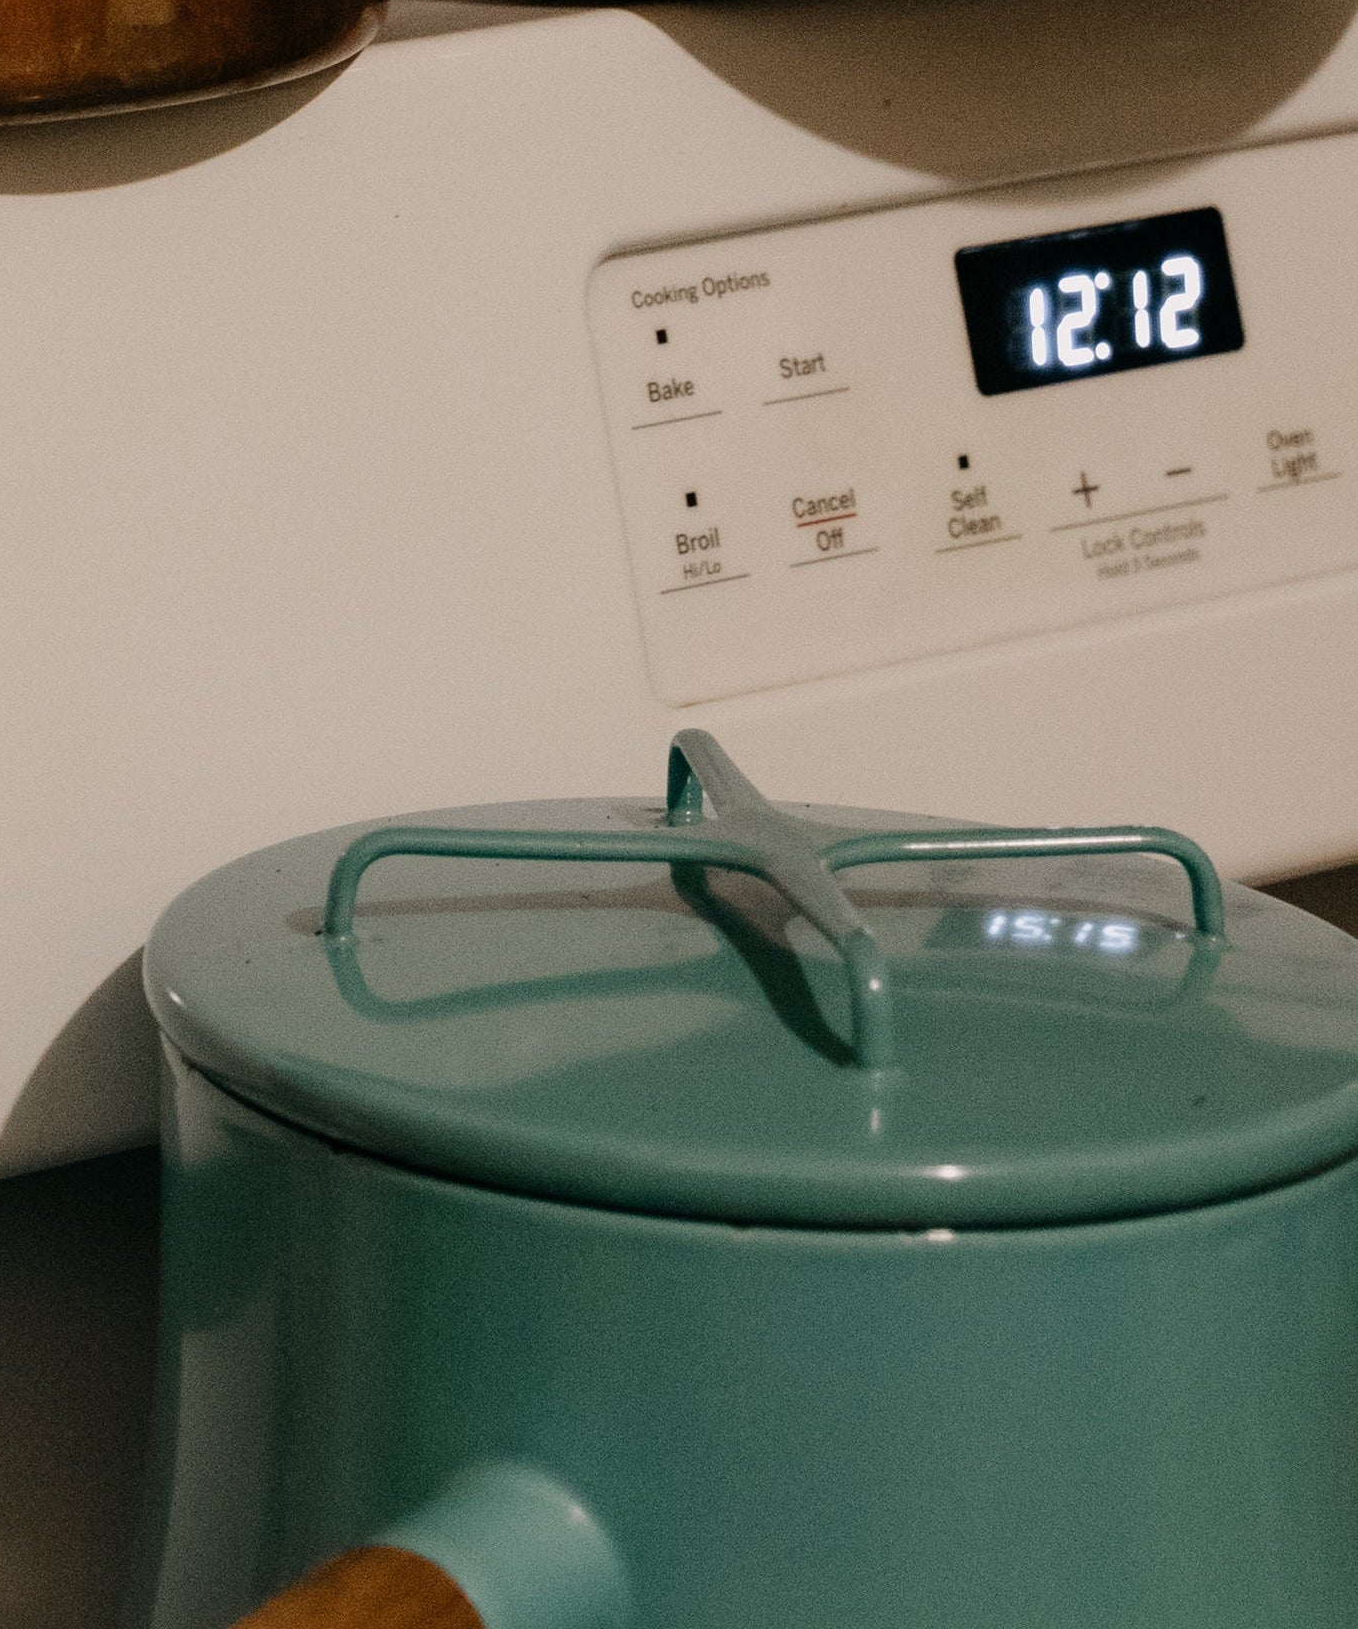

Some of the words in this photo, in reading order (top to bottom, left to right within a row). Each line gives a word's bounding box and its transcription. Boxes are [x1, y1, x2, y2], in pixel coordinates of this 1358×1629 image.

[631, 285, 700, 309] Cooking
[701, 271, 771, 299] Options
[1028, 255, 1201, 368] 12:12
[779, 352, 826, 379] Start
[647, 378, 695, 403] Bake
[792, 488, 857, 519] Cancel
[951, 484, 987, 511] Self
[816, 527, 844, 552] Off
[948, 514, 1002, 539] Clean
[675, 527, 721, 556] Broil
